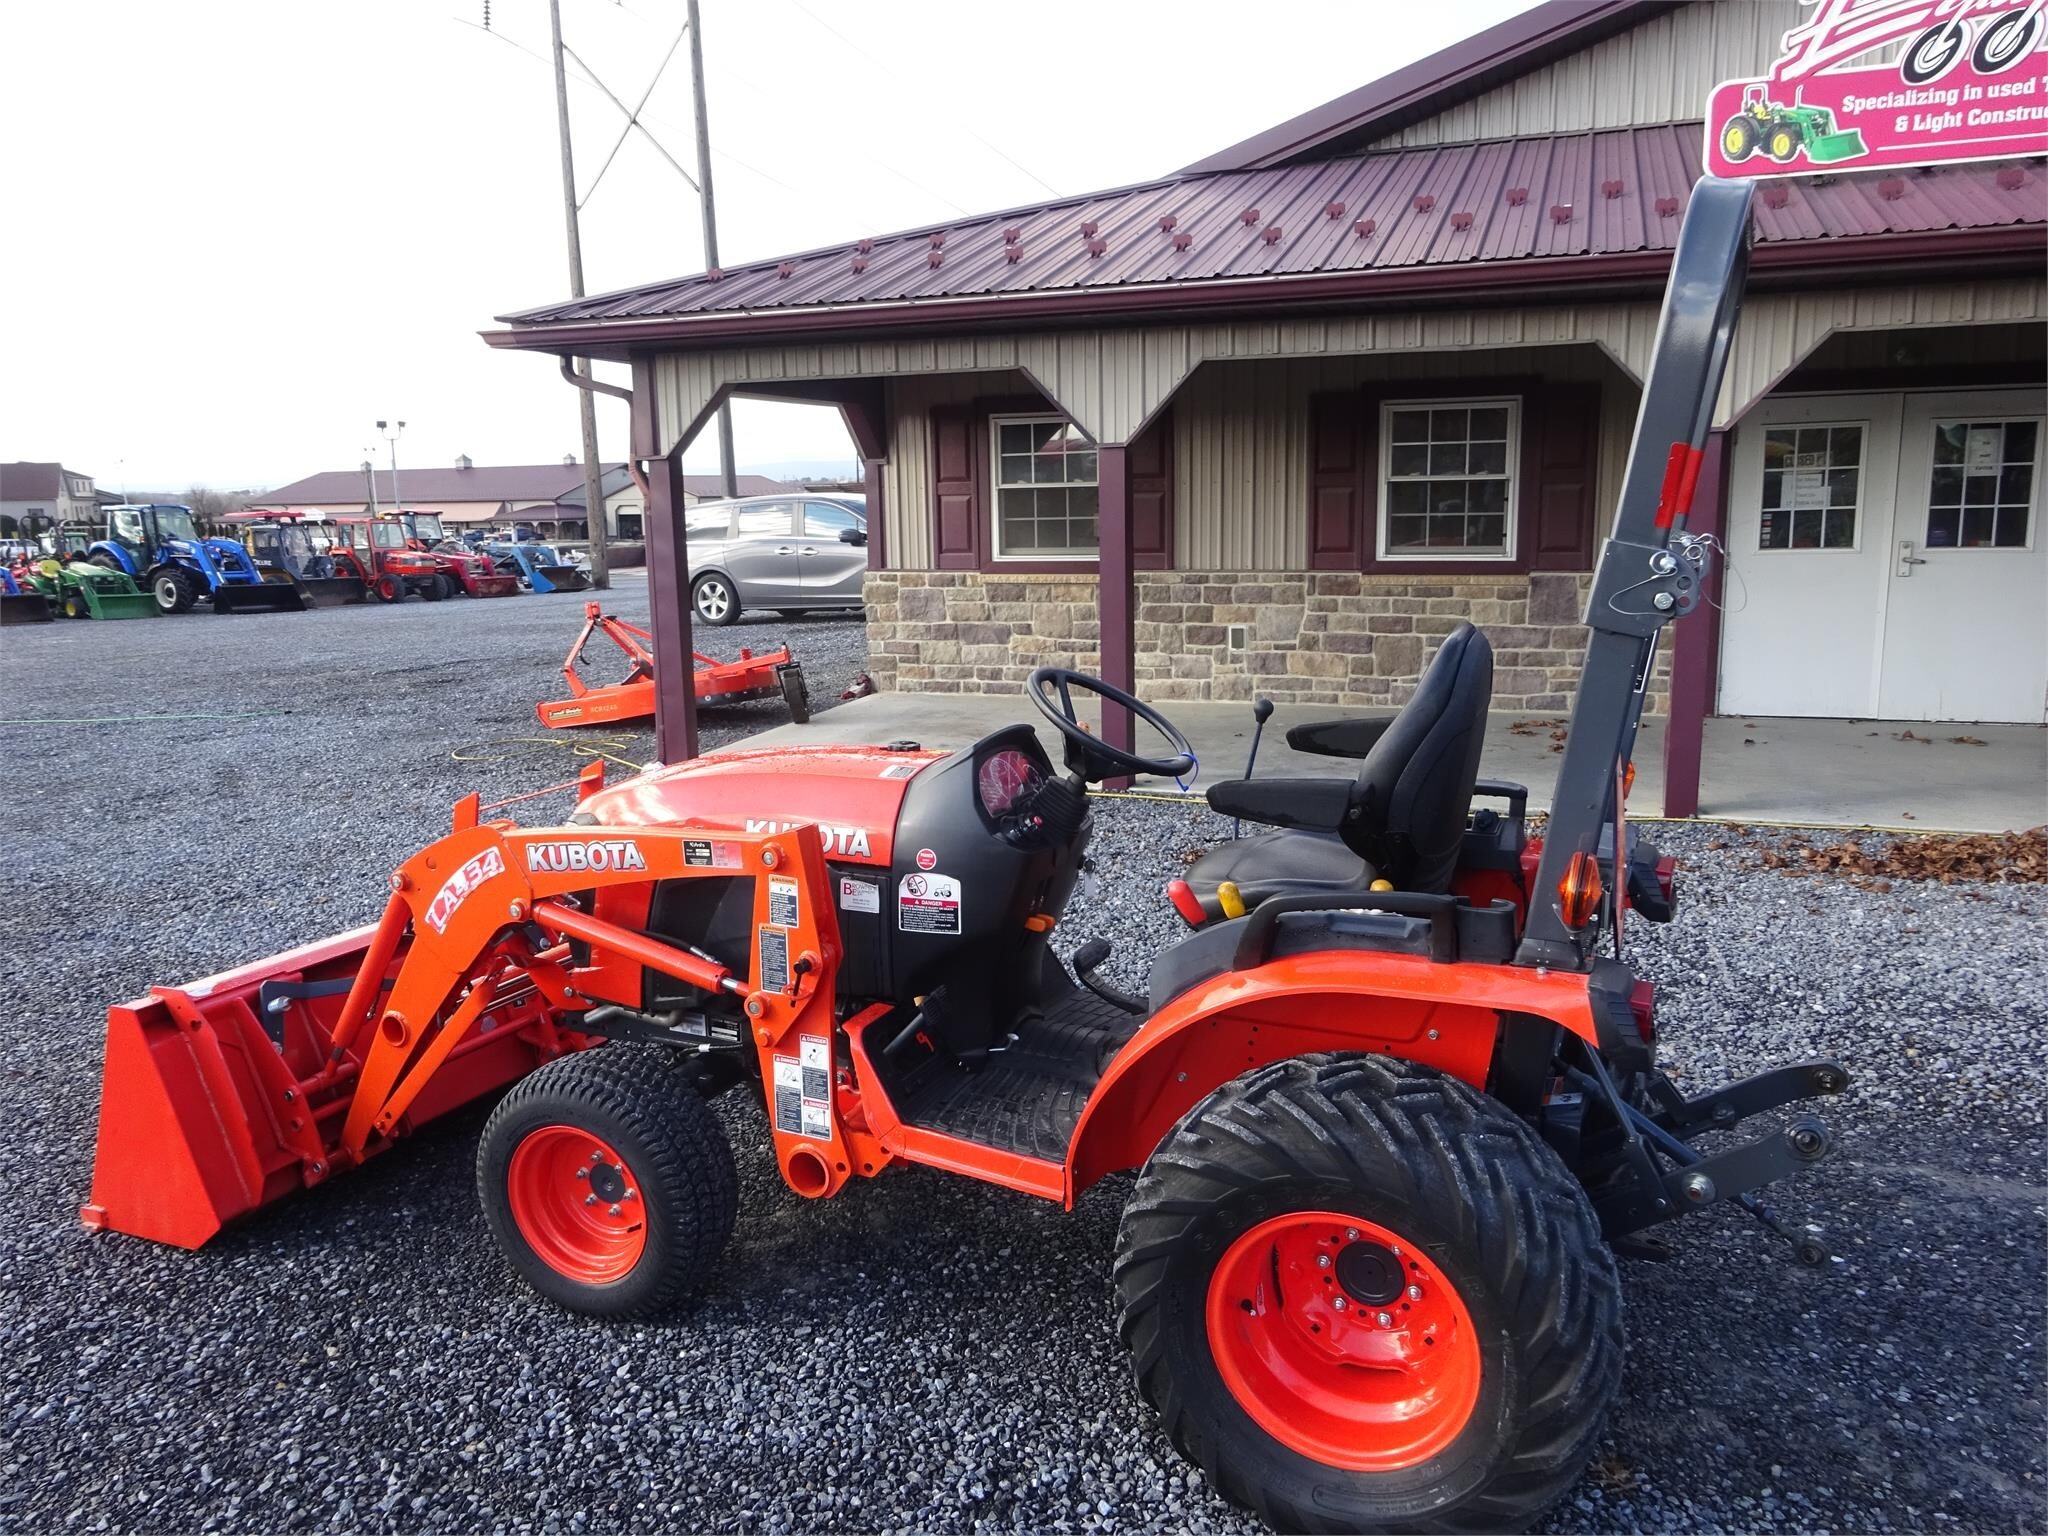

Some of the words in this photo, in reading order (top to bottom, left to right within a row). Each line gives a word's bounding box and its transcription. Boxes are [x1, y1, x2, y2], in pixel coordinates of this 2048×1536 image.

[1842, 87, 1958, 113] Specializing
[1963, 83, 1984, 101] in
[1987, 77, 2036, 98] used
[1895, 116, 1909, 133] &
[1914, 111, 1962, 134] Light
[527, 841, 647, 871] KUBOTA
[746, 819, 872, 857] KOTA
[426, 850, 502, 932] LA434
